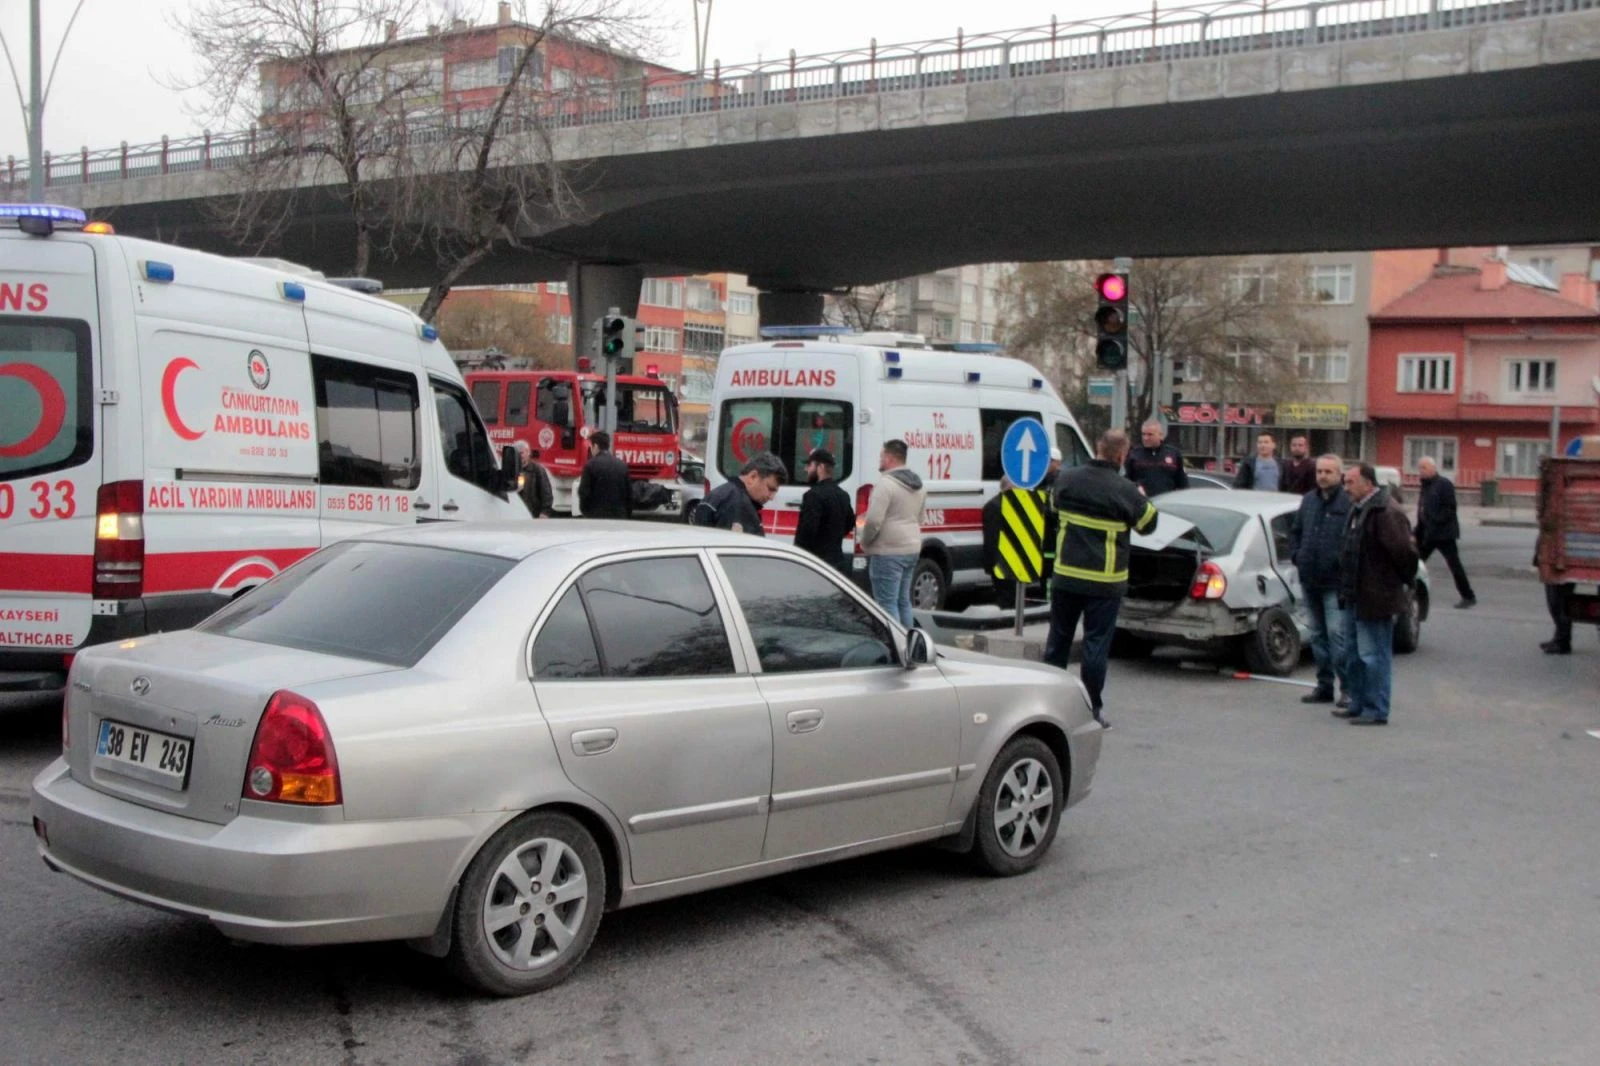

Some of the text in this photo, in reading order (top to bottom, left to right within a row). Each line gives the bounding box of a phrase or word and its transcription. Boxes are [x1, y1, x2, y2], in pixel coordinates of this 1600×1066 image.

[730, 369, 836, 387] AMBULANS
[214, 414, 310, 440] AMBULANS
[904, 429, 975, 450] SAĞLIK BAKANLIĞI
[928, 454, 951, 480] 112
[30, 480, 76, 519] 33
[148, 482, 316, 509] ACİL YARDIM AMBULANSI
[348, 493, 373, 511] 636
[378, 495, 390, 512] 11
[395, 496, 408, 512] 18
[107, 726, 187, 773] 38 EV 243
